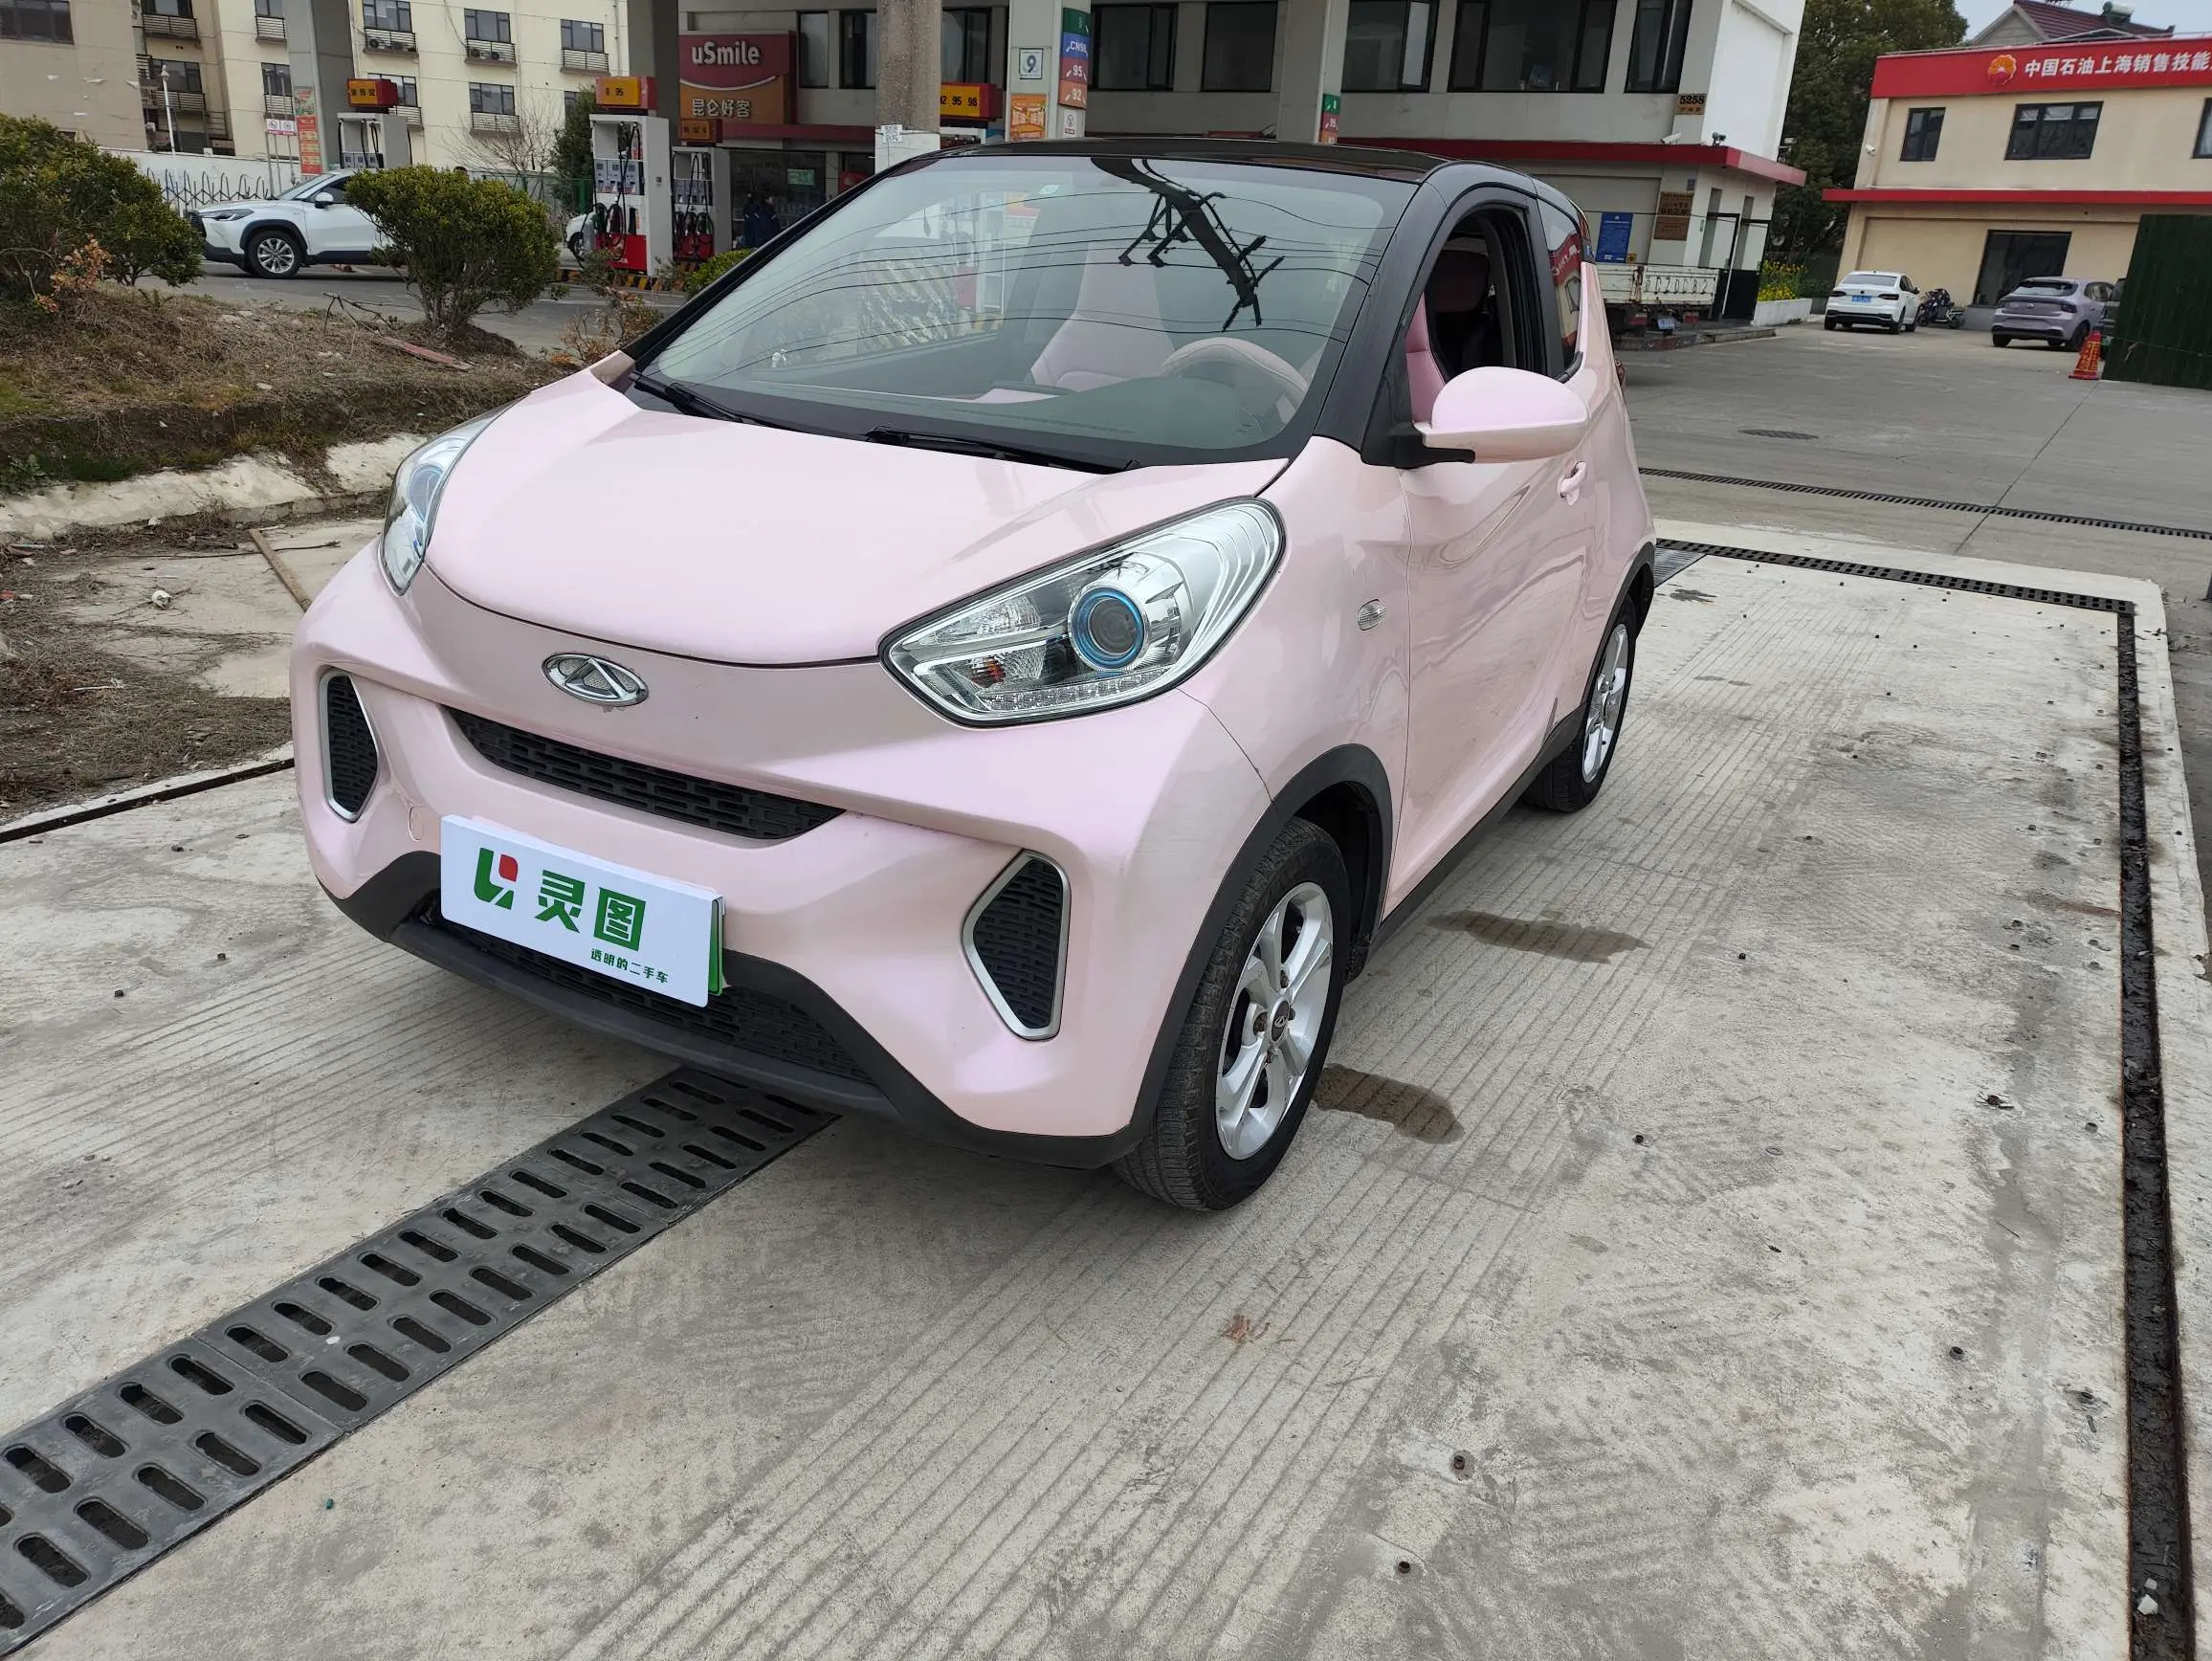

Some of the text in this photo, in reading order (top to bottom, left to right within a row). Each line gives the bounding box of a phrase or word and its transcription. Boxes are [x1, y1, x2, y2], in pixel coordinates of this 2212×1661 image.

[692, 41, 761, 65] uSmile
[1026, 55, 1037, 73] 9
[1073, 64, 1083, 77] 95
[2024, 52, 2212, 78] 中国石油上海销售技能
[952, 96, 962, 105] 95
[967, 97, 978, 106] 98
[1072, 88, 1082, 100] 92
[1679, 95, 1705, 105] 5258
[692, 99, 750, 118] 昆仑好客
[534, 869, 647, 952] 灵图
[590, 948, 669, 983] 透明的二手车
